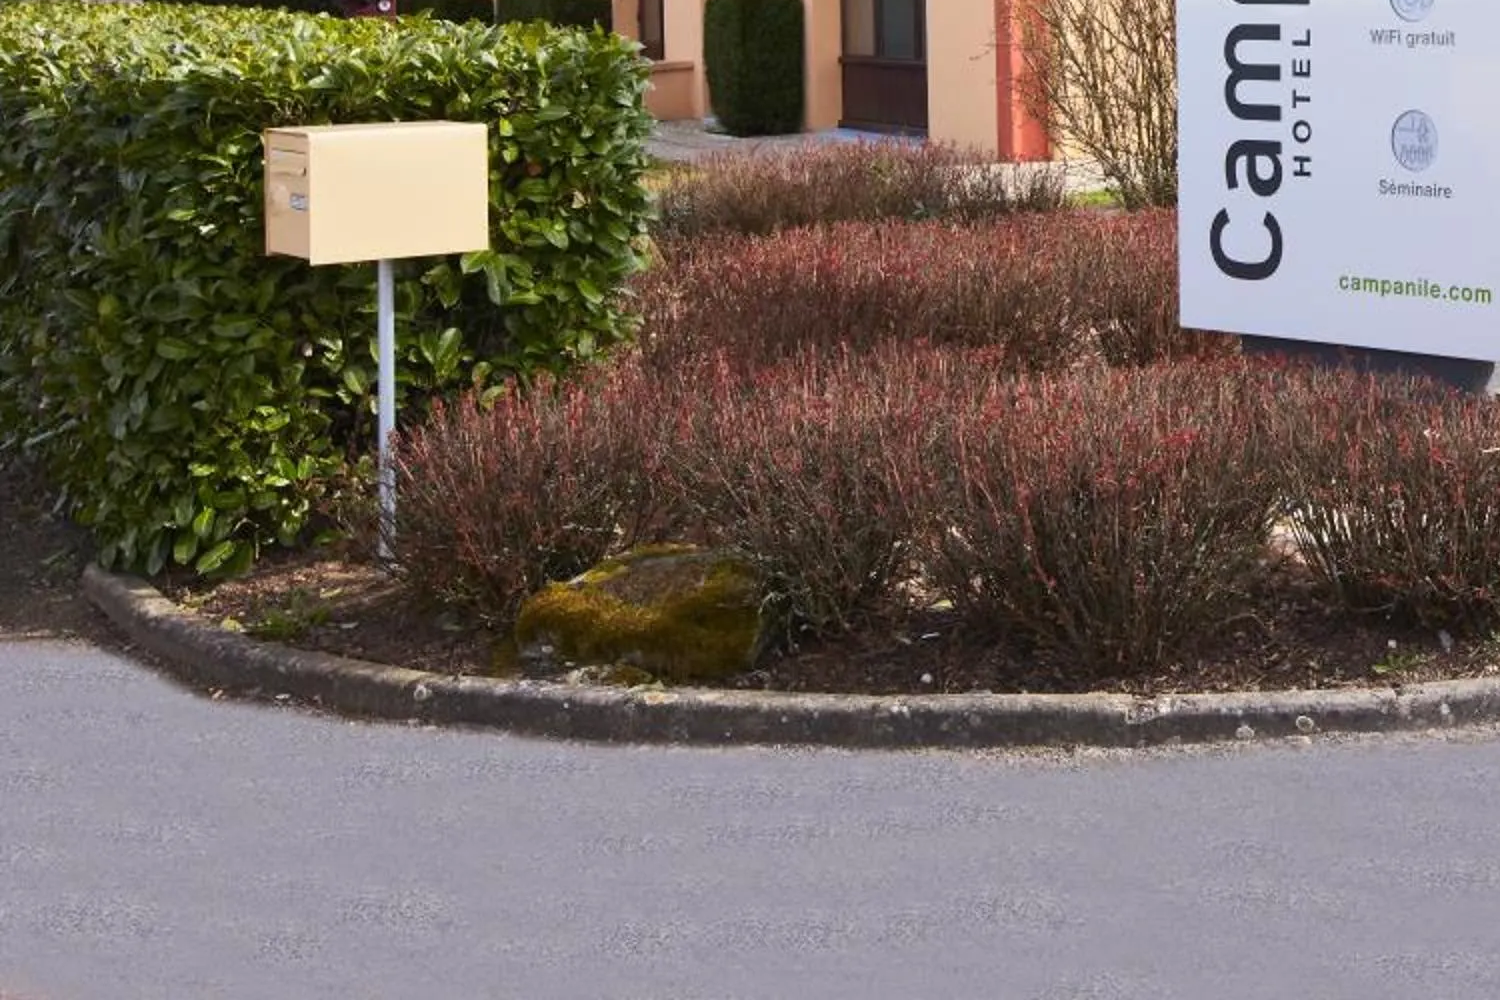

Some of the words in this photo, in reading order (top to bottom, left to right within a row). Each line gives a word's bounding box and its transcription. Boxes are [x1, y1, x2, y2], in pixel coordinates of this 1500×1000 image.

[1370, 29, 1401, 45] WiFi
[1406, 30, 1456, 48] gratuit
[1291, 28, 1313, 178] HOTEL
[1378, 178, 1453, 199] Séminaire
[1338, 273, 1493, 305] campanile.com
